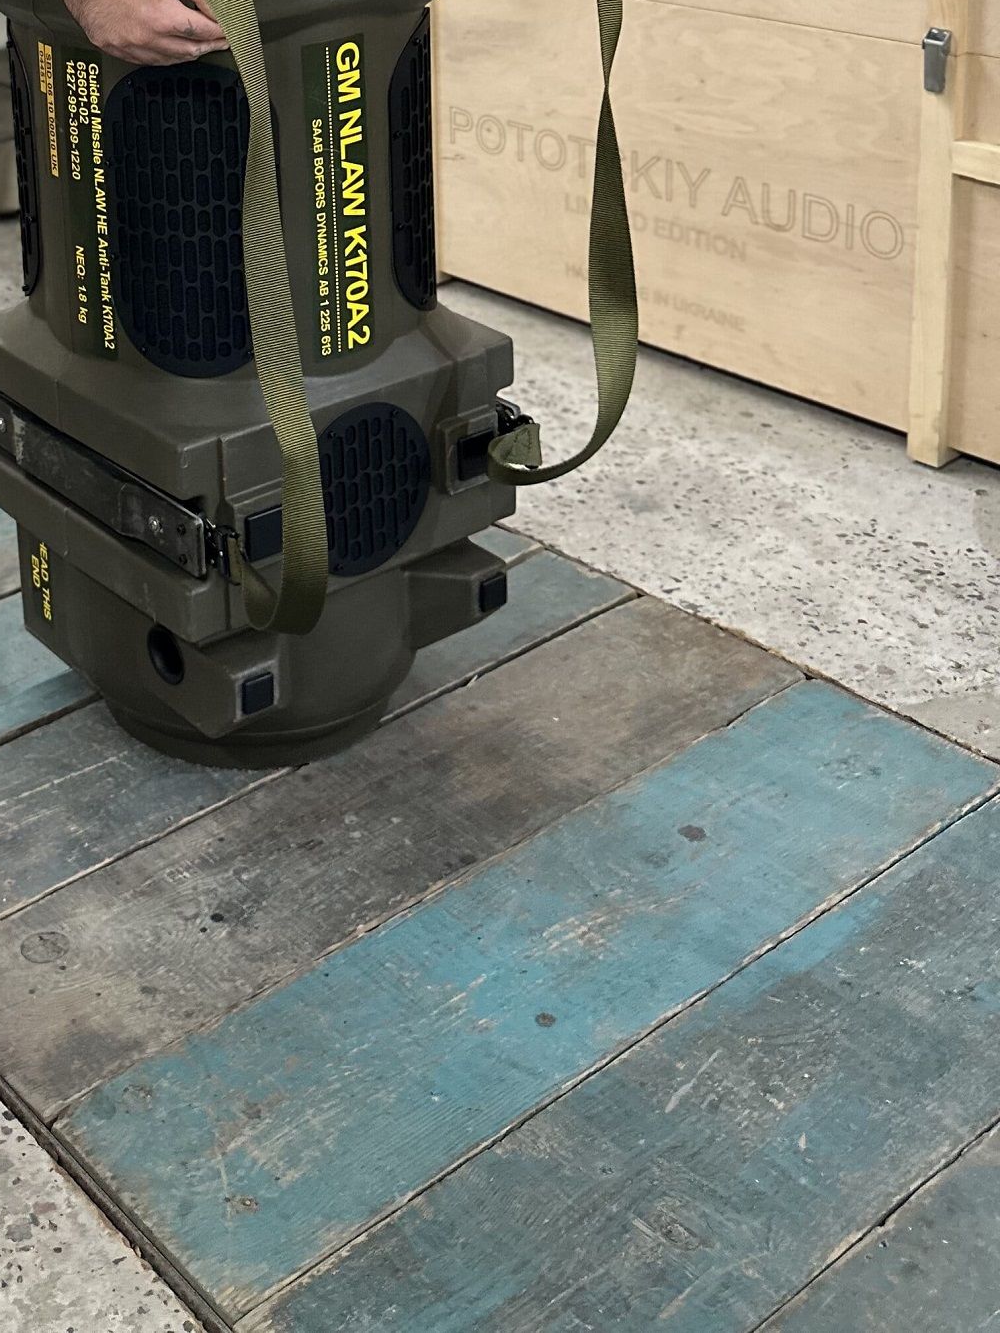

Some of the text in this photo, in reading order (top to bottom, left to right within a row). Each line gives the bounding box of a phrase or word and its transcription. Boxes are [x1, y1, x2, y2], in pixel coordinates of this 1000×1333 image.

[65, 59, 82, 181] 1427-99-309-1220
[76, 61, 90, 125] 65601-02
[88, 63, 116, 350] Guided Missile NLAW HE Anti-Tank K170A2
[311, 118, 332, 357] SAAB BOFORS DYNAMICS AB 1 225 613
[335, 41, 371, 350] GM NLAW K170A2
[448, 105, 712, 209] POTOTKIY
[720, 174, 904, 260] AUDIO
[75, 245, 89, 324] NEQ: 1.8 kg
[31, 553, 41, 588] END
[42, 587, 52, 621] THIS
